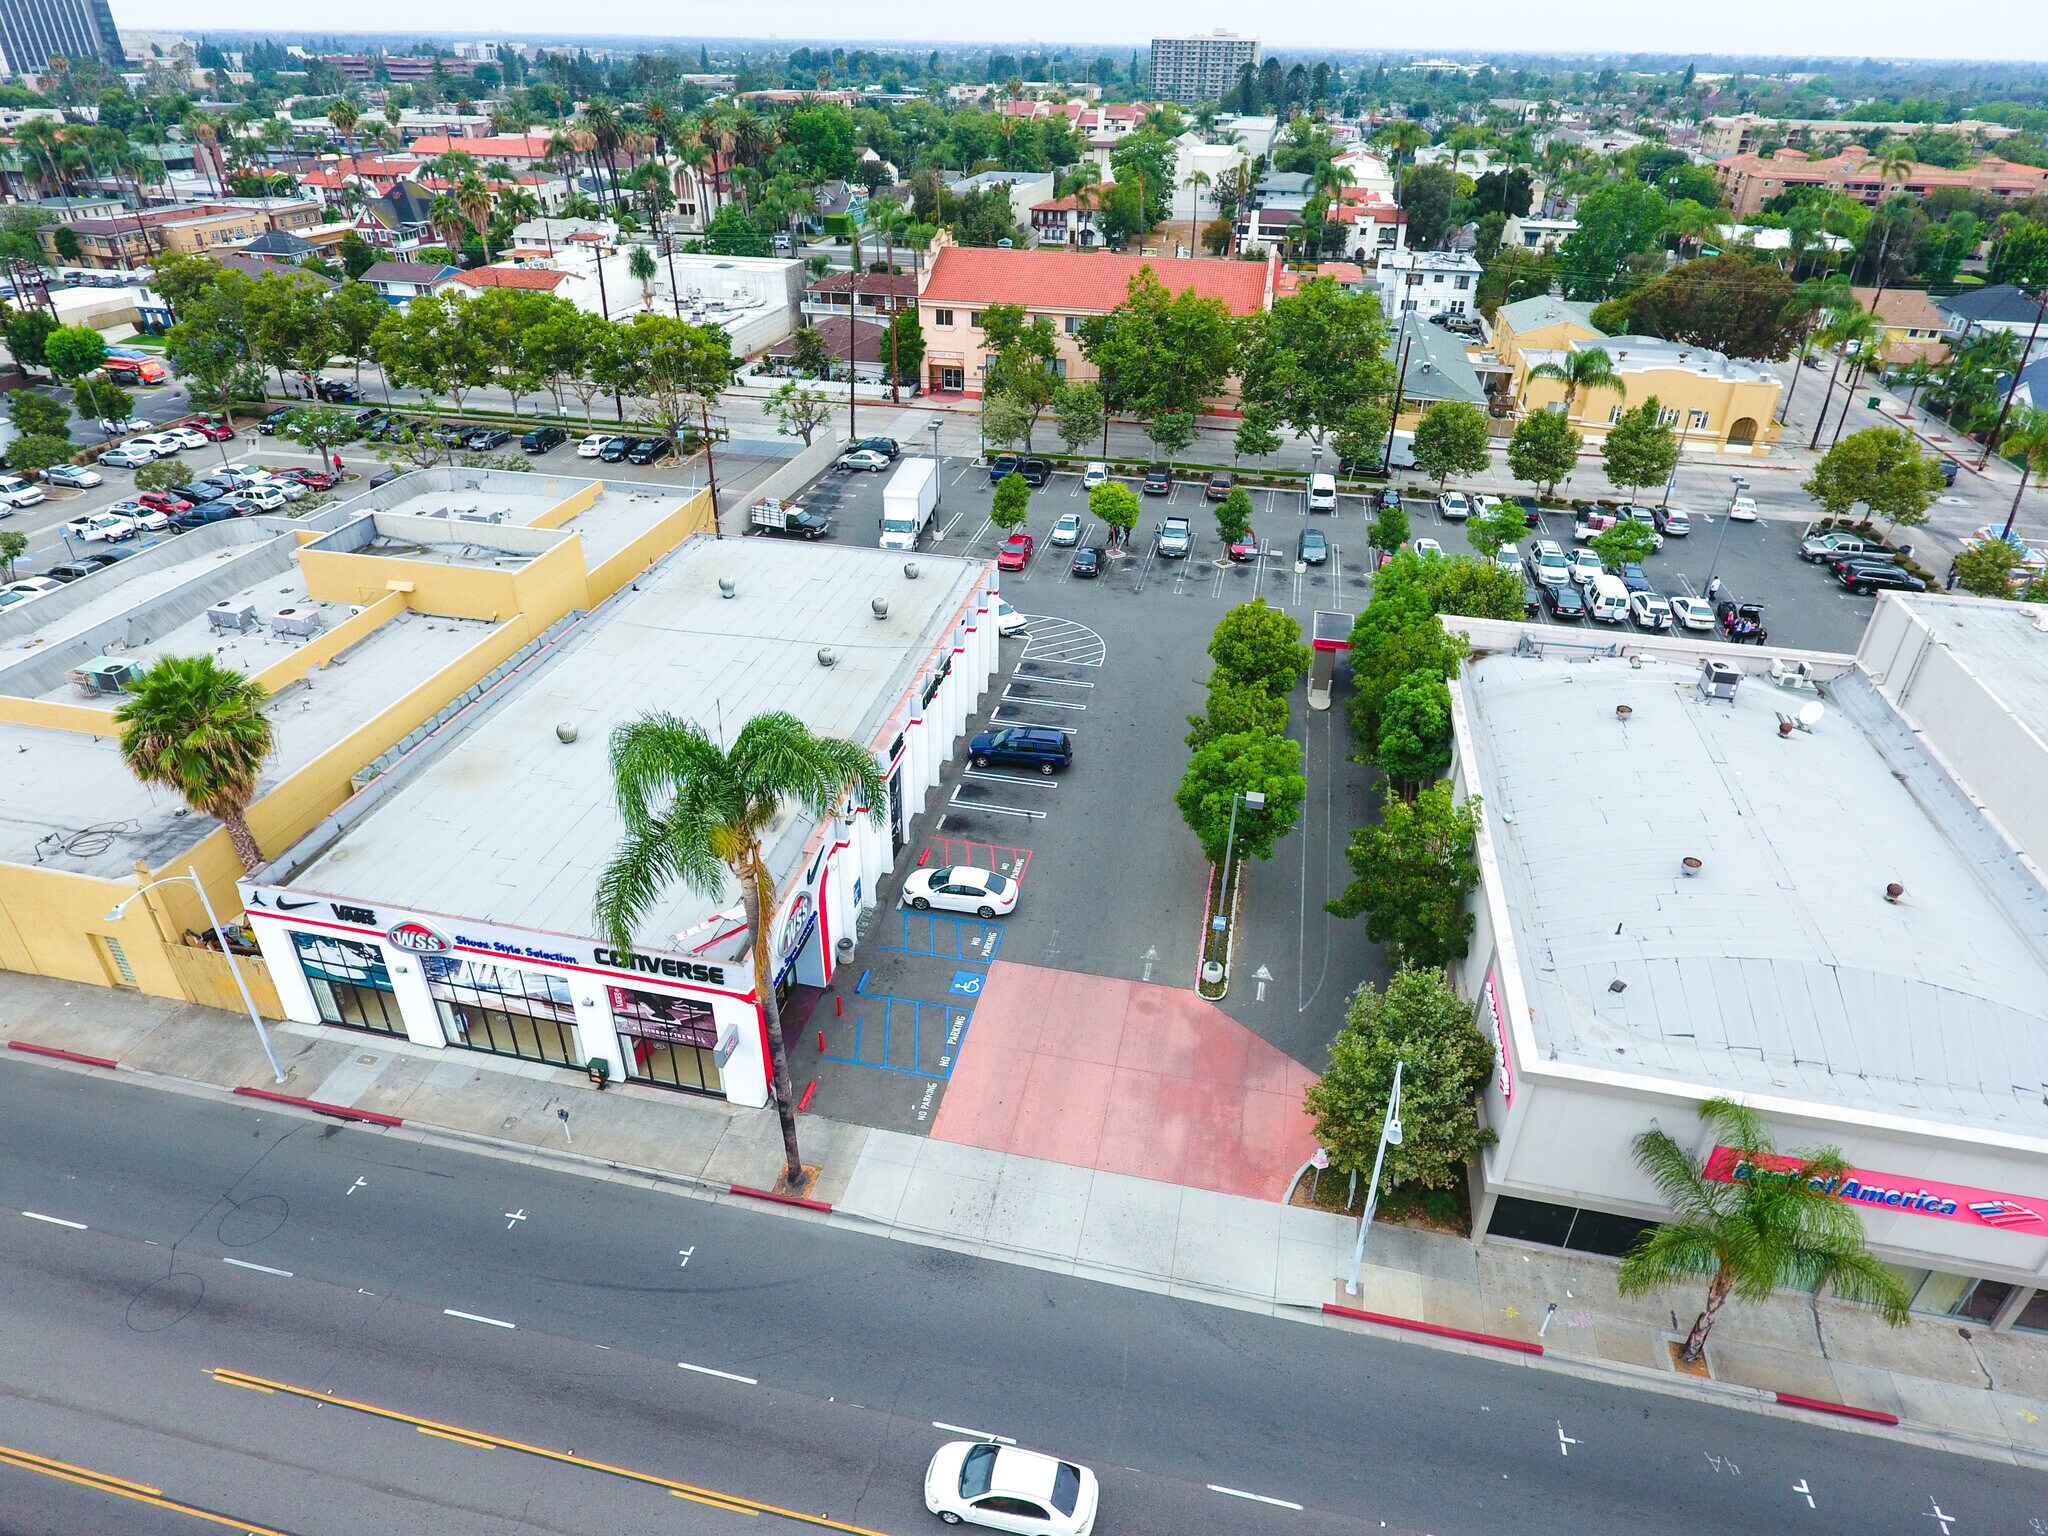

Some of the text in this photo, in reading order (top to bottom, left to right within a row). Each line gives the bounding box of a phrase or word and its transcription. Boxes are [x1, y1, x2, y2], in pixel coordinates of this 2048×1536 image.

[1000, 862, 1010, 871] NO
[1010, 858, 1025, 879] PARKING
[330, 902, 377, 926] VANS
[393, 929, 440, 952] WSS
[455, 935, 580, 965] Shoes. Style. Selection.
[970, 936, 981, 947] NO
[981, 931, 998, 958] PARKING
[593, 947, 726, 986] CONVERSE
[946, 1015, 966, 1045] PARKING
[939, 1056, 951, 1068] NO
[917, 1082, 938, 1121] NO PARKING
[1807, 1175, 1840, 1194] of
[1837, 1178, 1959, 1216] America
